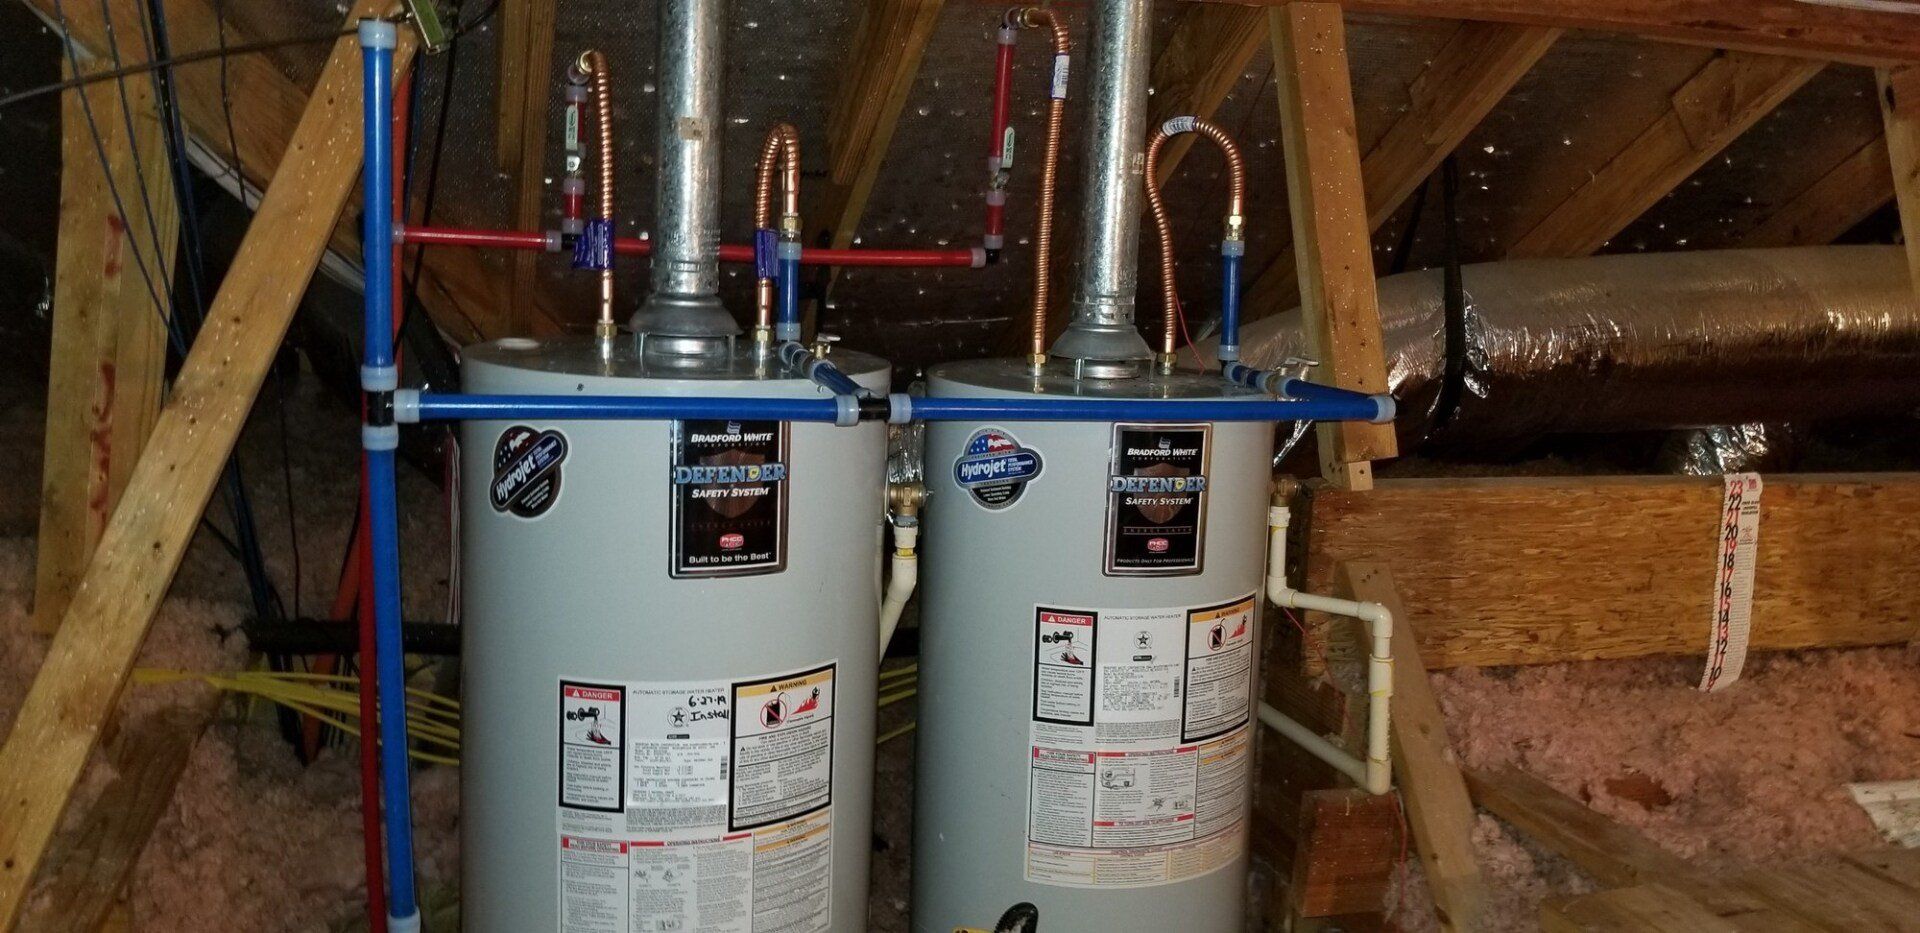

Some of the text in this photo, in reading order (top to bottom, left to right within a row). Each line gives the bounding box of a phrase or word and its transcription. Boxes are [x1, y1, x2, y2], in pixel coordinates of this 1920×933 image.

[691, 433, 772, 443] BRADFORD WHITE
[1127, 448, 1197, 456] BRADFORD WHITE
[675, 464, 786, 484] DEFENDER
[961, 459, 1007, 480] Hydrojet
[496, 454, 536, 500] Hydrojet
[1111, 476, 1206, 492] DEFENDER
[691, 488, 769, 498] SAFETY SYSTEM
[1730, 480, 1743, 495] 23
[1125, 497, 1192, 506] SAFETY SYSTEM
[1728, 494, 1742, 510] 22
[1725, 524, 1738, 540] 20
[689, 555, 708, 563] Built
[710, 555, 719, 563] to
[721, 554, 732, 562] be
[750, 553, 769, 561] Best
[1723, 553, 1735, 569] 18
[1720, 582, 1732, 598] 16
[1718, 610, 1729, 622] 14
[1716, 639, 1728, 654] 12
[1709, 666, 1722, 680] 10
[778, 679, 807, 690] WARNING
[582, 690, 613, 699] DANGER
[689, 709, 729, 722] Install
